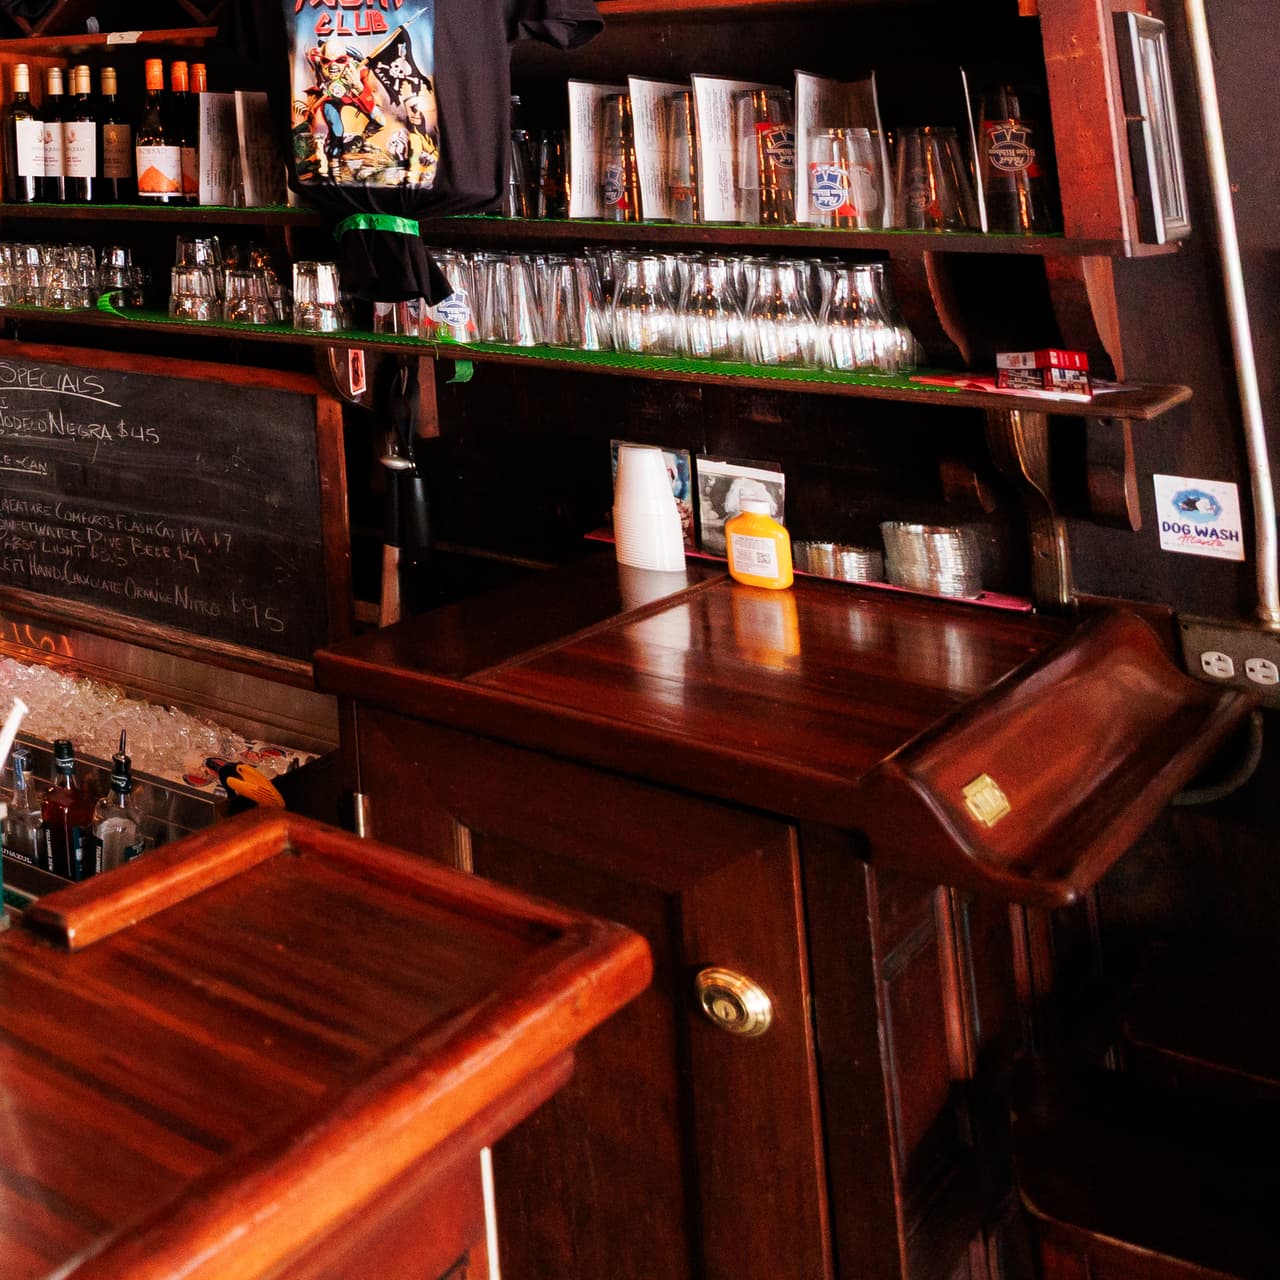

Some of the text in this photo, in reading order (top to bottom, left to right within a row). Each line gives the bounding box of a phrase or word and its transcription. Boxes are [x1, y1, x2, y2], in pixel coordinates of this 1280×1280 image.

[314, 9, 389, 36] CLUB
[48, 408, 112, 440] NEGRA
[55, 503, 114, 528] COMFORTS
[116, 514, 154, 535] FLASH
[1162, 521, 1239, 542] DOG WASH
[1178, 534, 1225, 546] Atlanta
